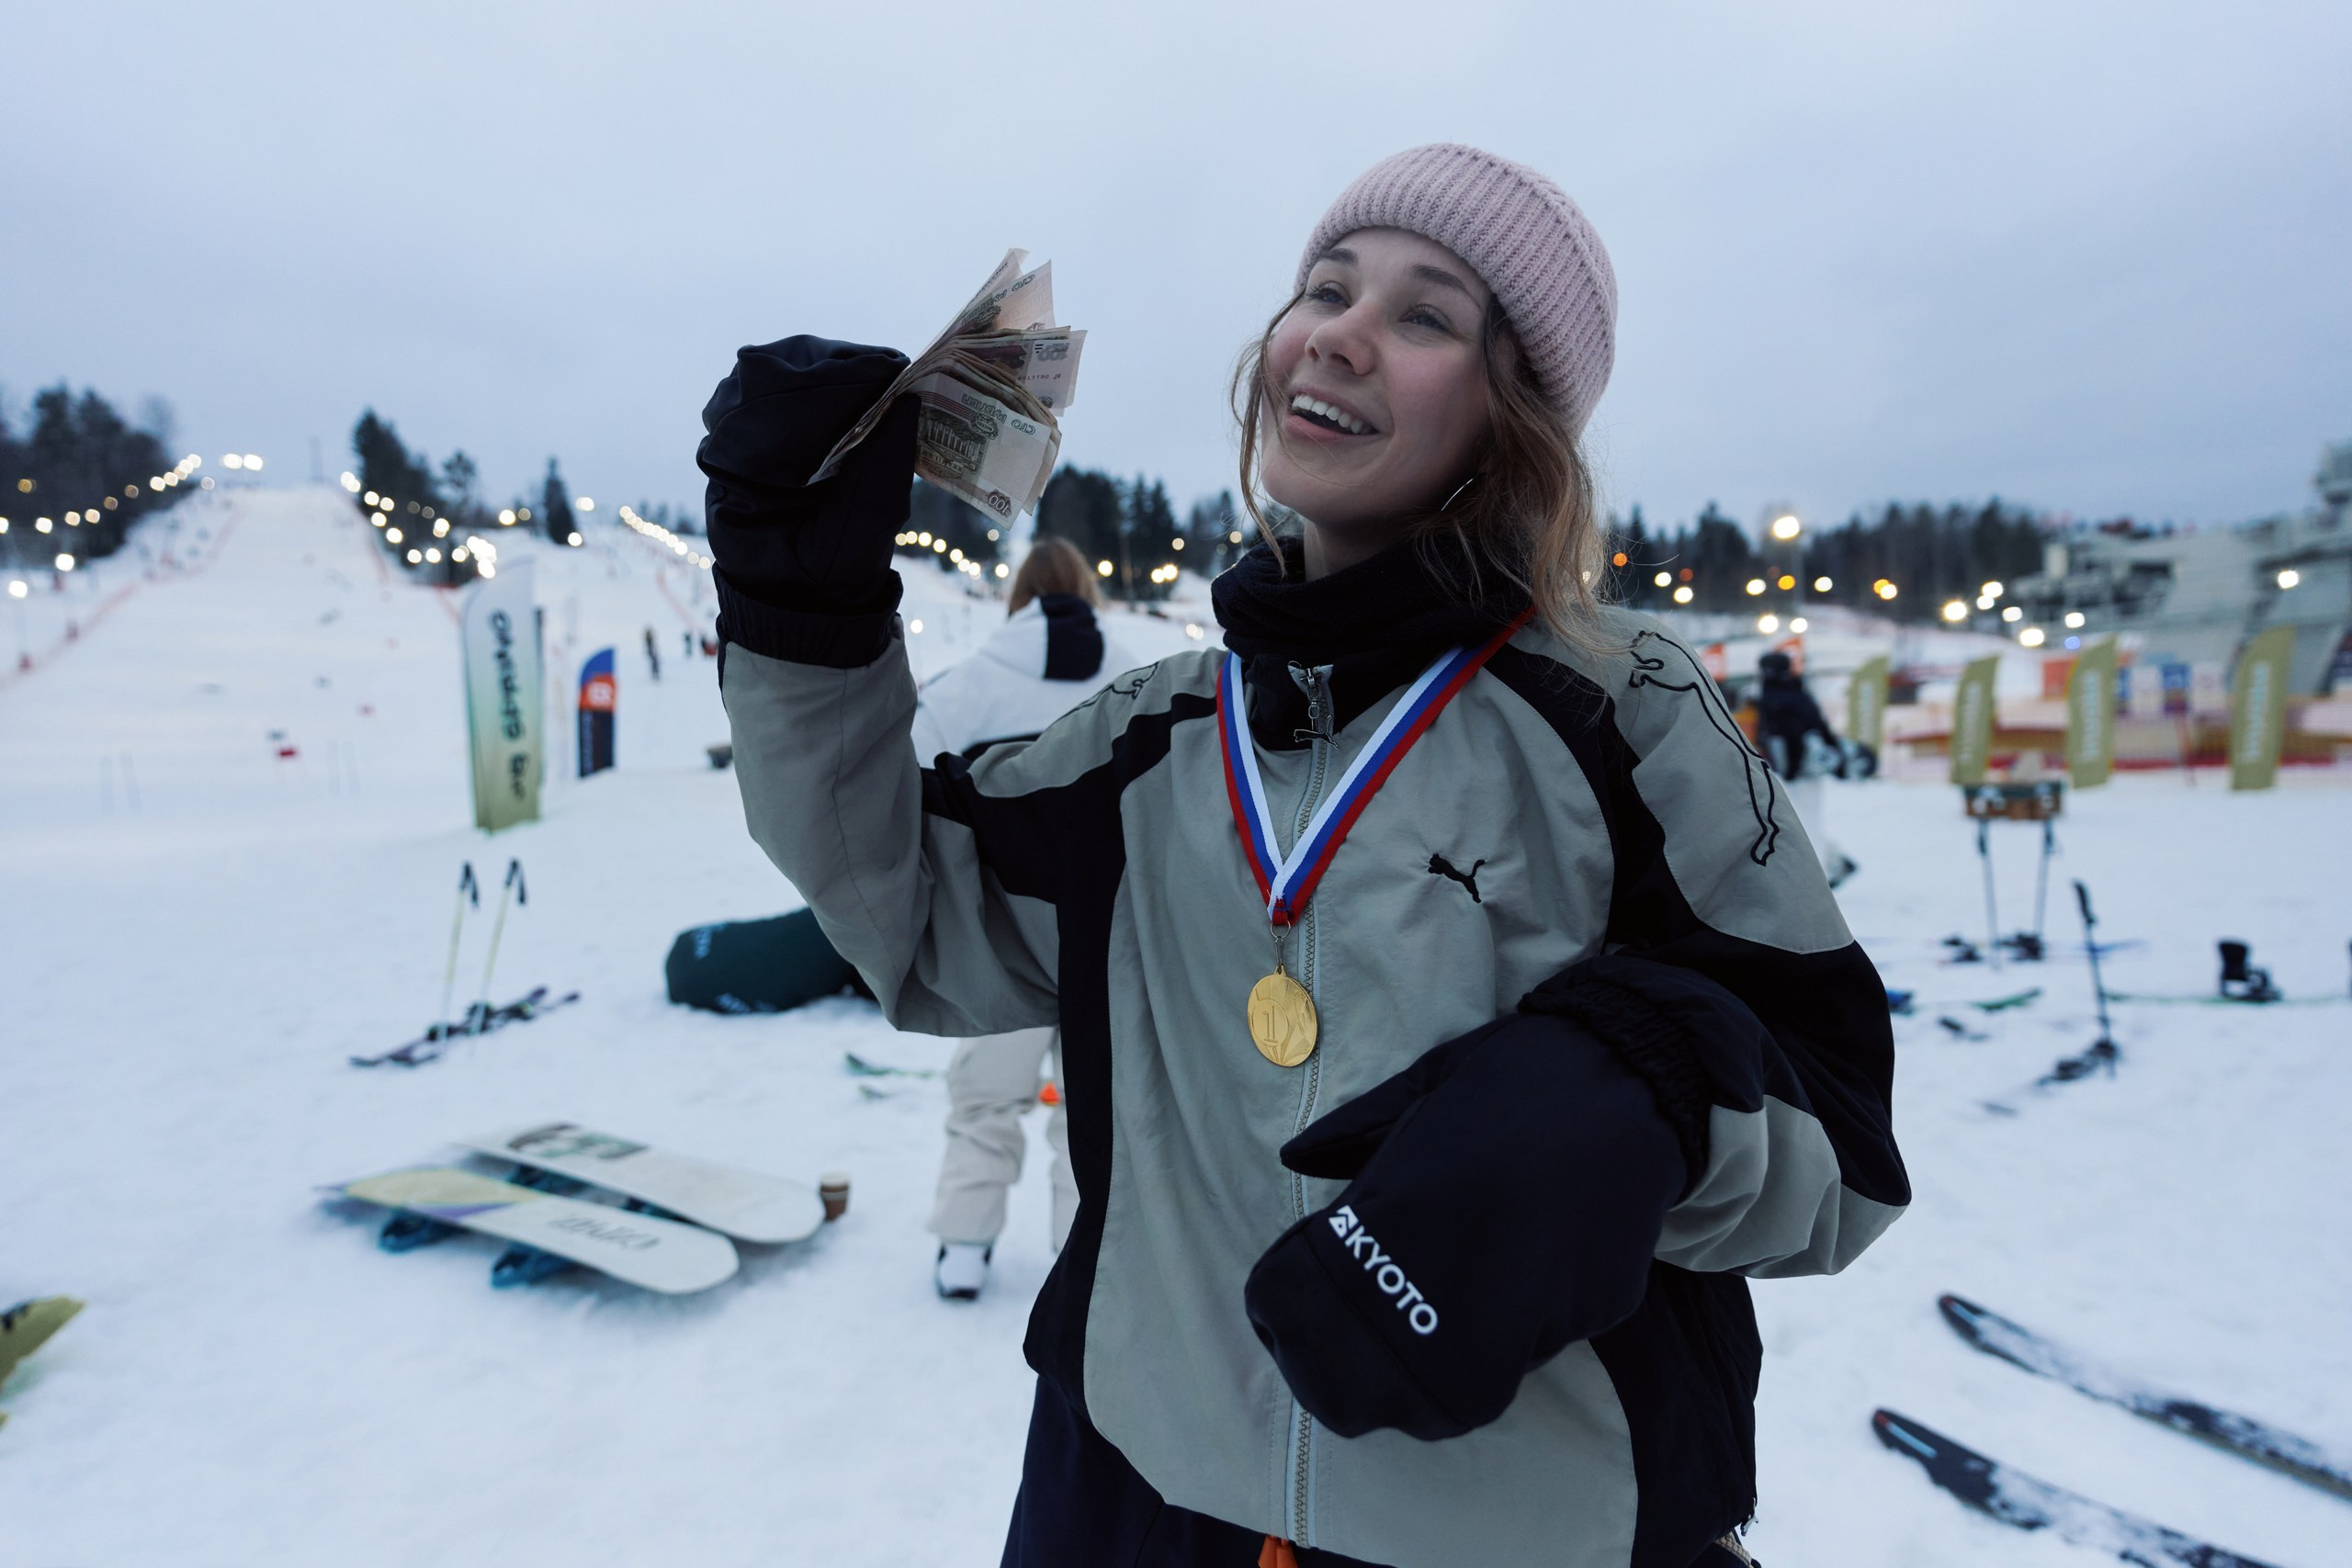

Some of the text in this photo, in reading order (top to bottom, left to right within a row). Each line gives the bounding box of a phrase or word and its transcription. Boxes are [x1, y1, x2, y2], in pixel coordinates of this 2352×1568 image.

[1012, 274, 1035, 292] СТО
[1011, 418, 1036, 435] СТО
[988, 493, 1012, 514] 100
[1262, 1004, 1279, 1043] 1
[1344, 1224, 1439, 1336] KYOTO
